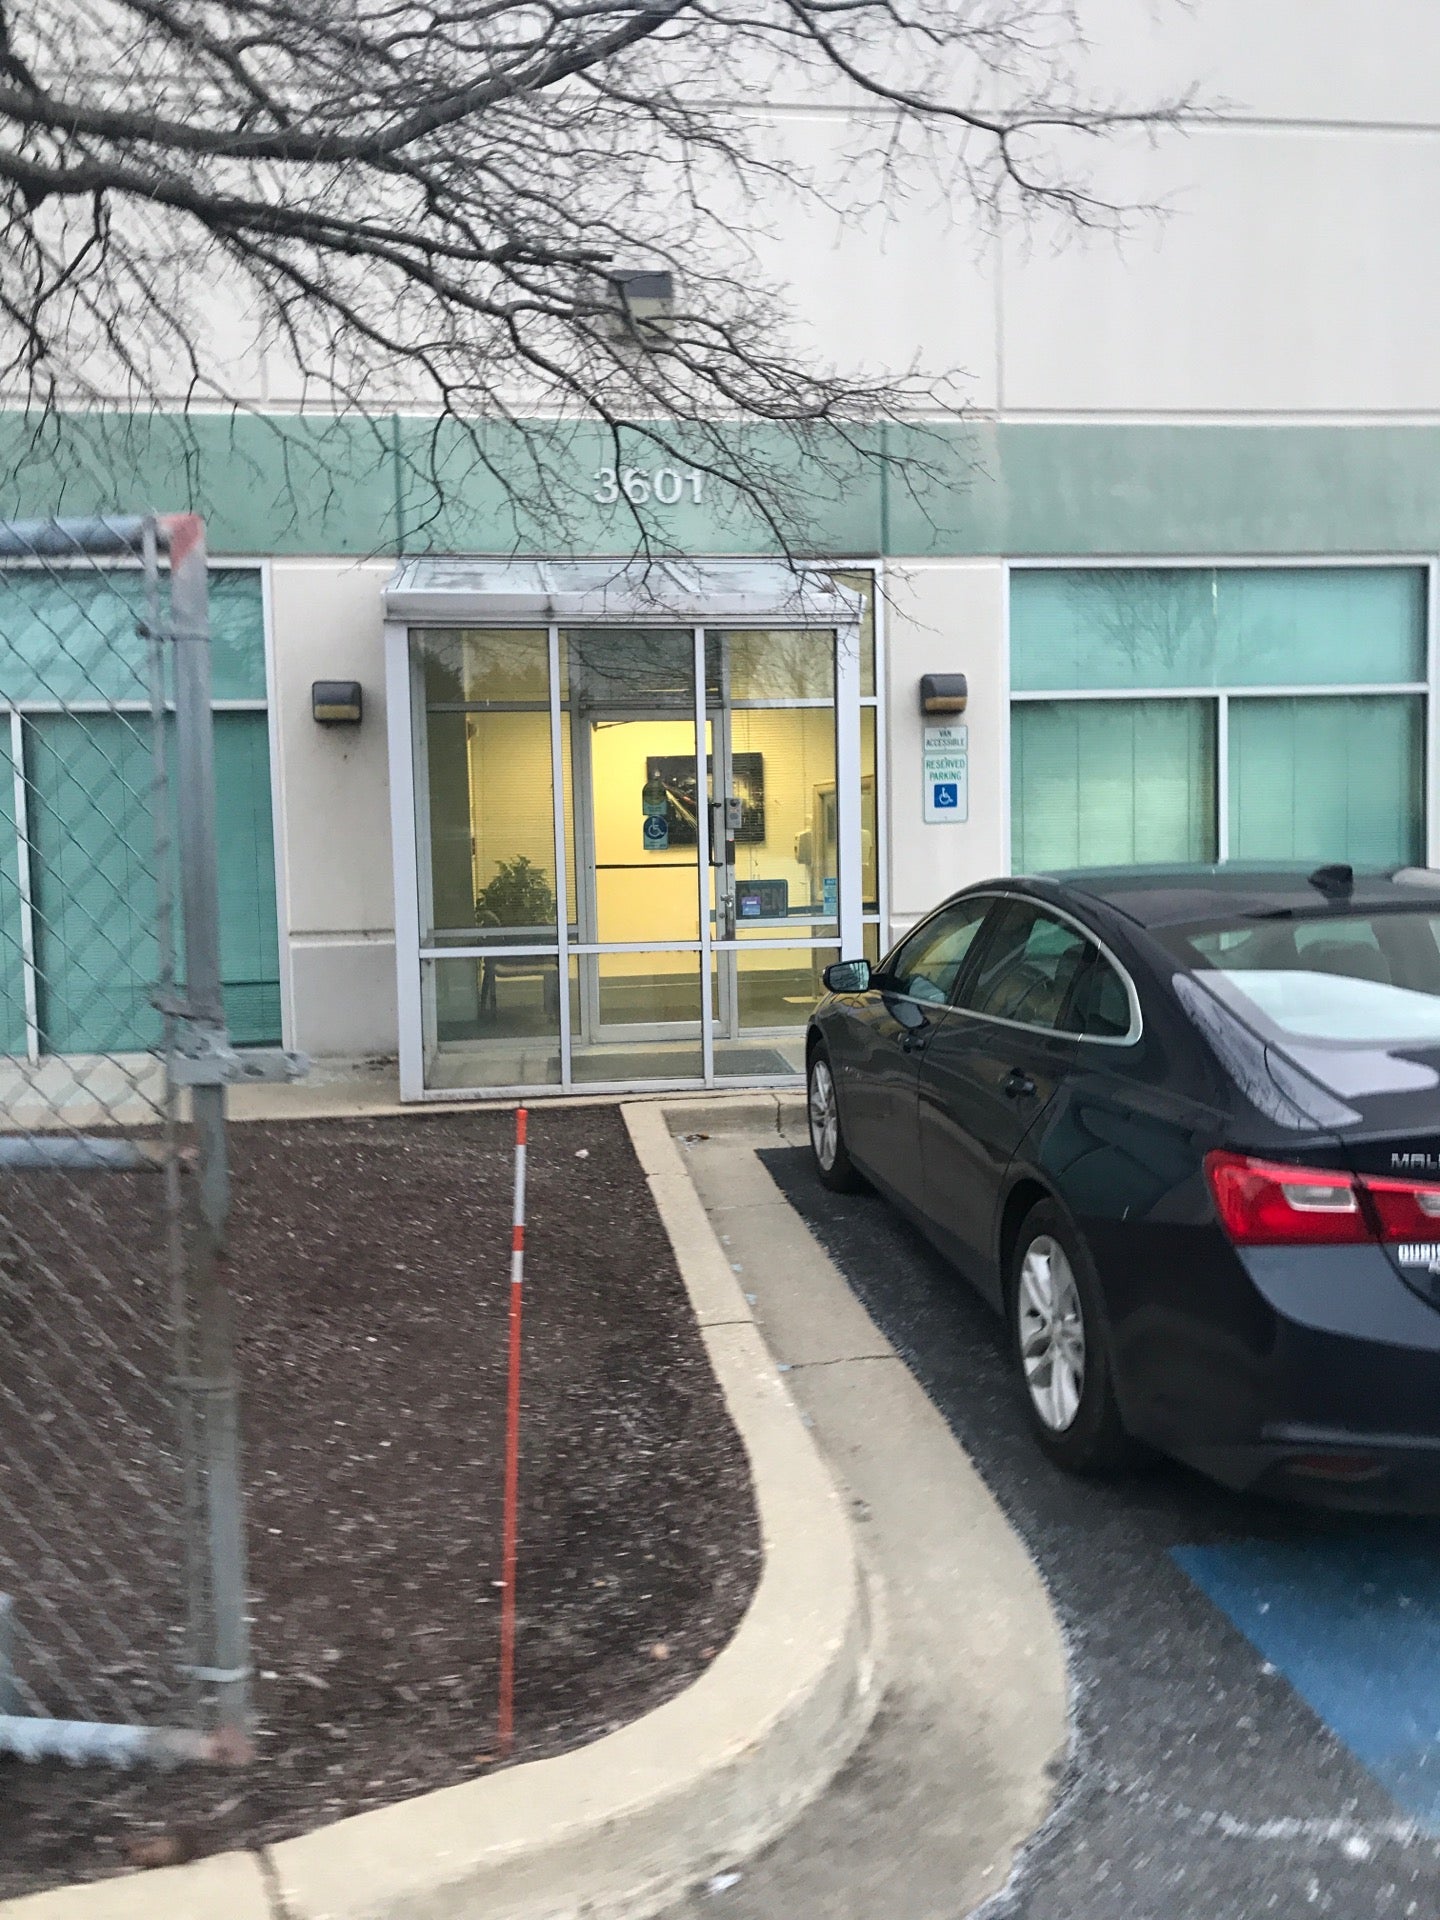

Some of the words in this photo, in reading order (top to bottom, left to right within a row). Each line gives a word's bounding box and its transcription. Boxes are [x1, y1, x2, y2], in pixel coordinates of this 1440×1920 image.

[594, 467, 703, 504] 3601
[926, 738, 965, 747] ACCESSIBLE
[926, 759, 966, 769] RESERVED
[929, 771, 962, 781] PARKING
[1391, 1152, 1440, 1169] MAL
